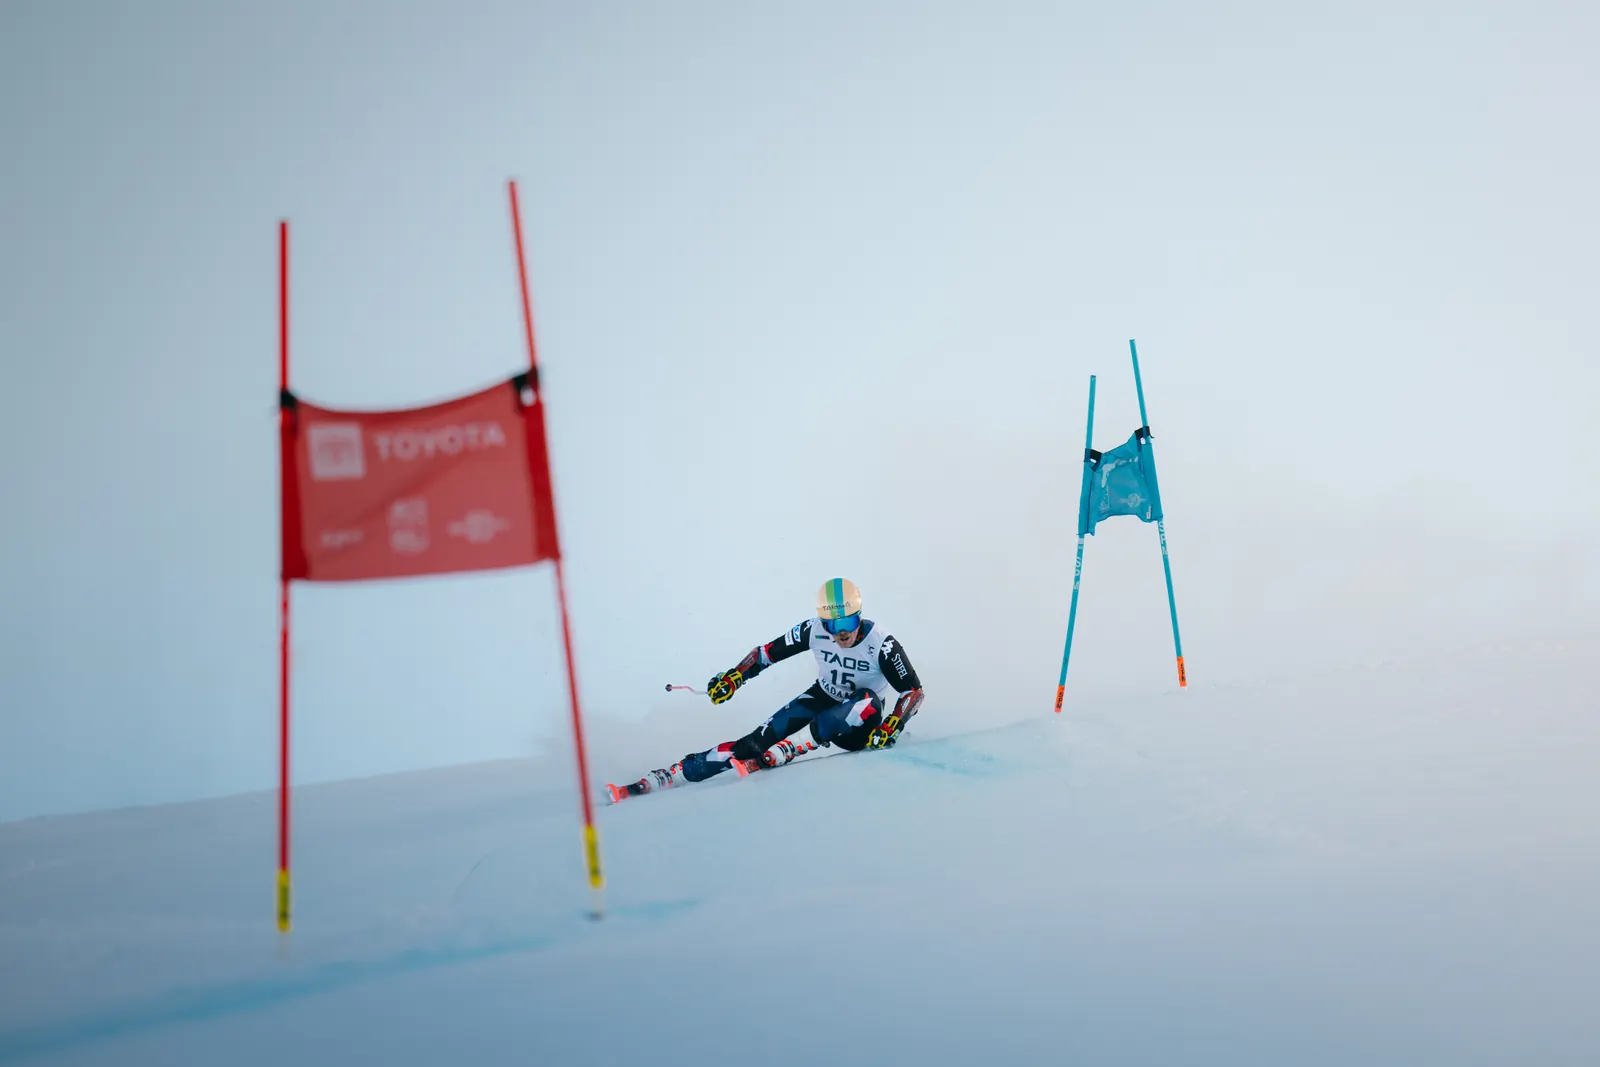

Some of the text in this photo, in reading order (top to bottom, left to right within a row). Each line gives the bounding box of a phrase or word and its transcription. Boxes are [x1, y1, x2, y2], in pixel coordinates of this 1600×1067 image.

[375, 422, 506, 461] TOYOTA
[820, 650, 870, 671] TAOS
[891, 653, 908, 680] STIFEL
[830, 669, 856, 692] 15
